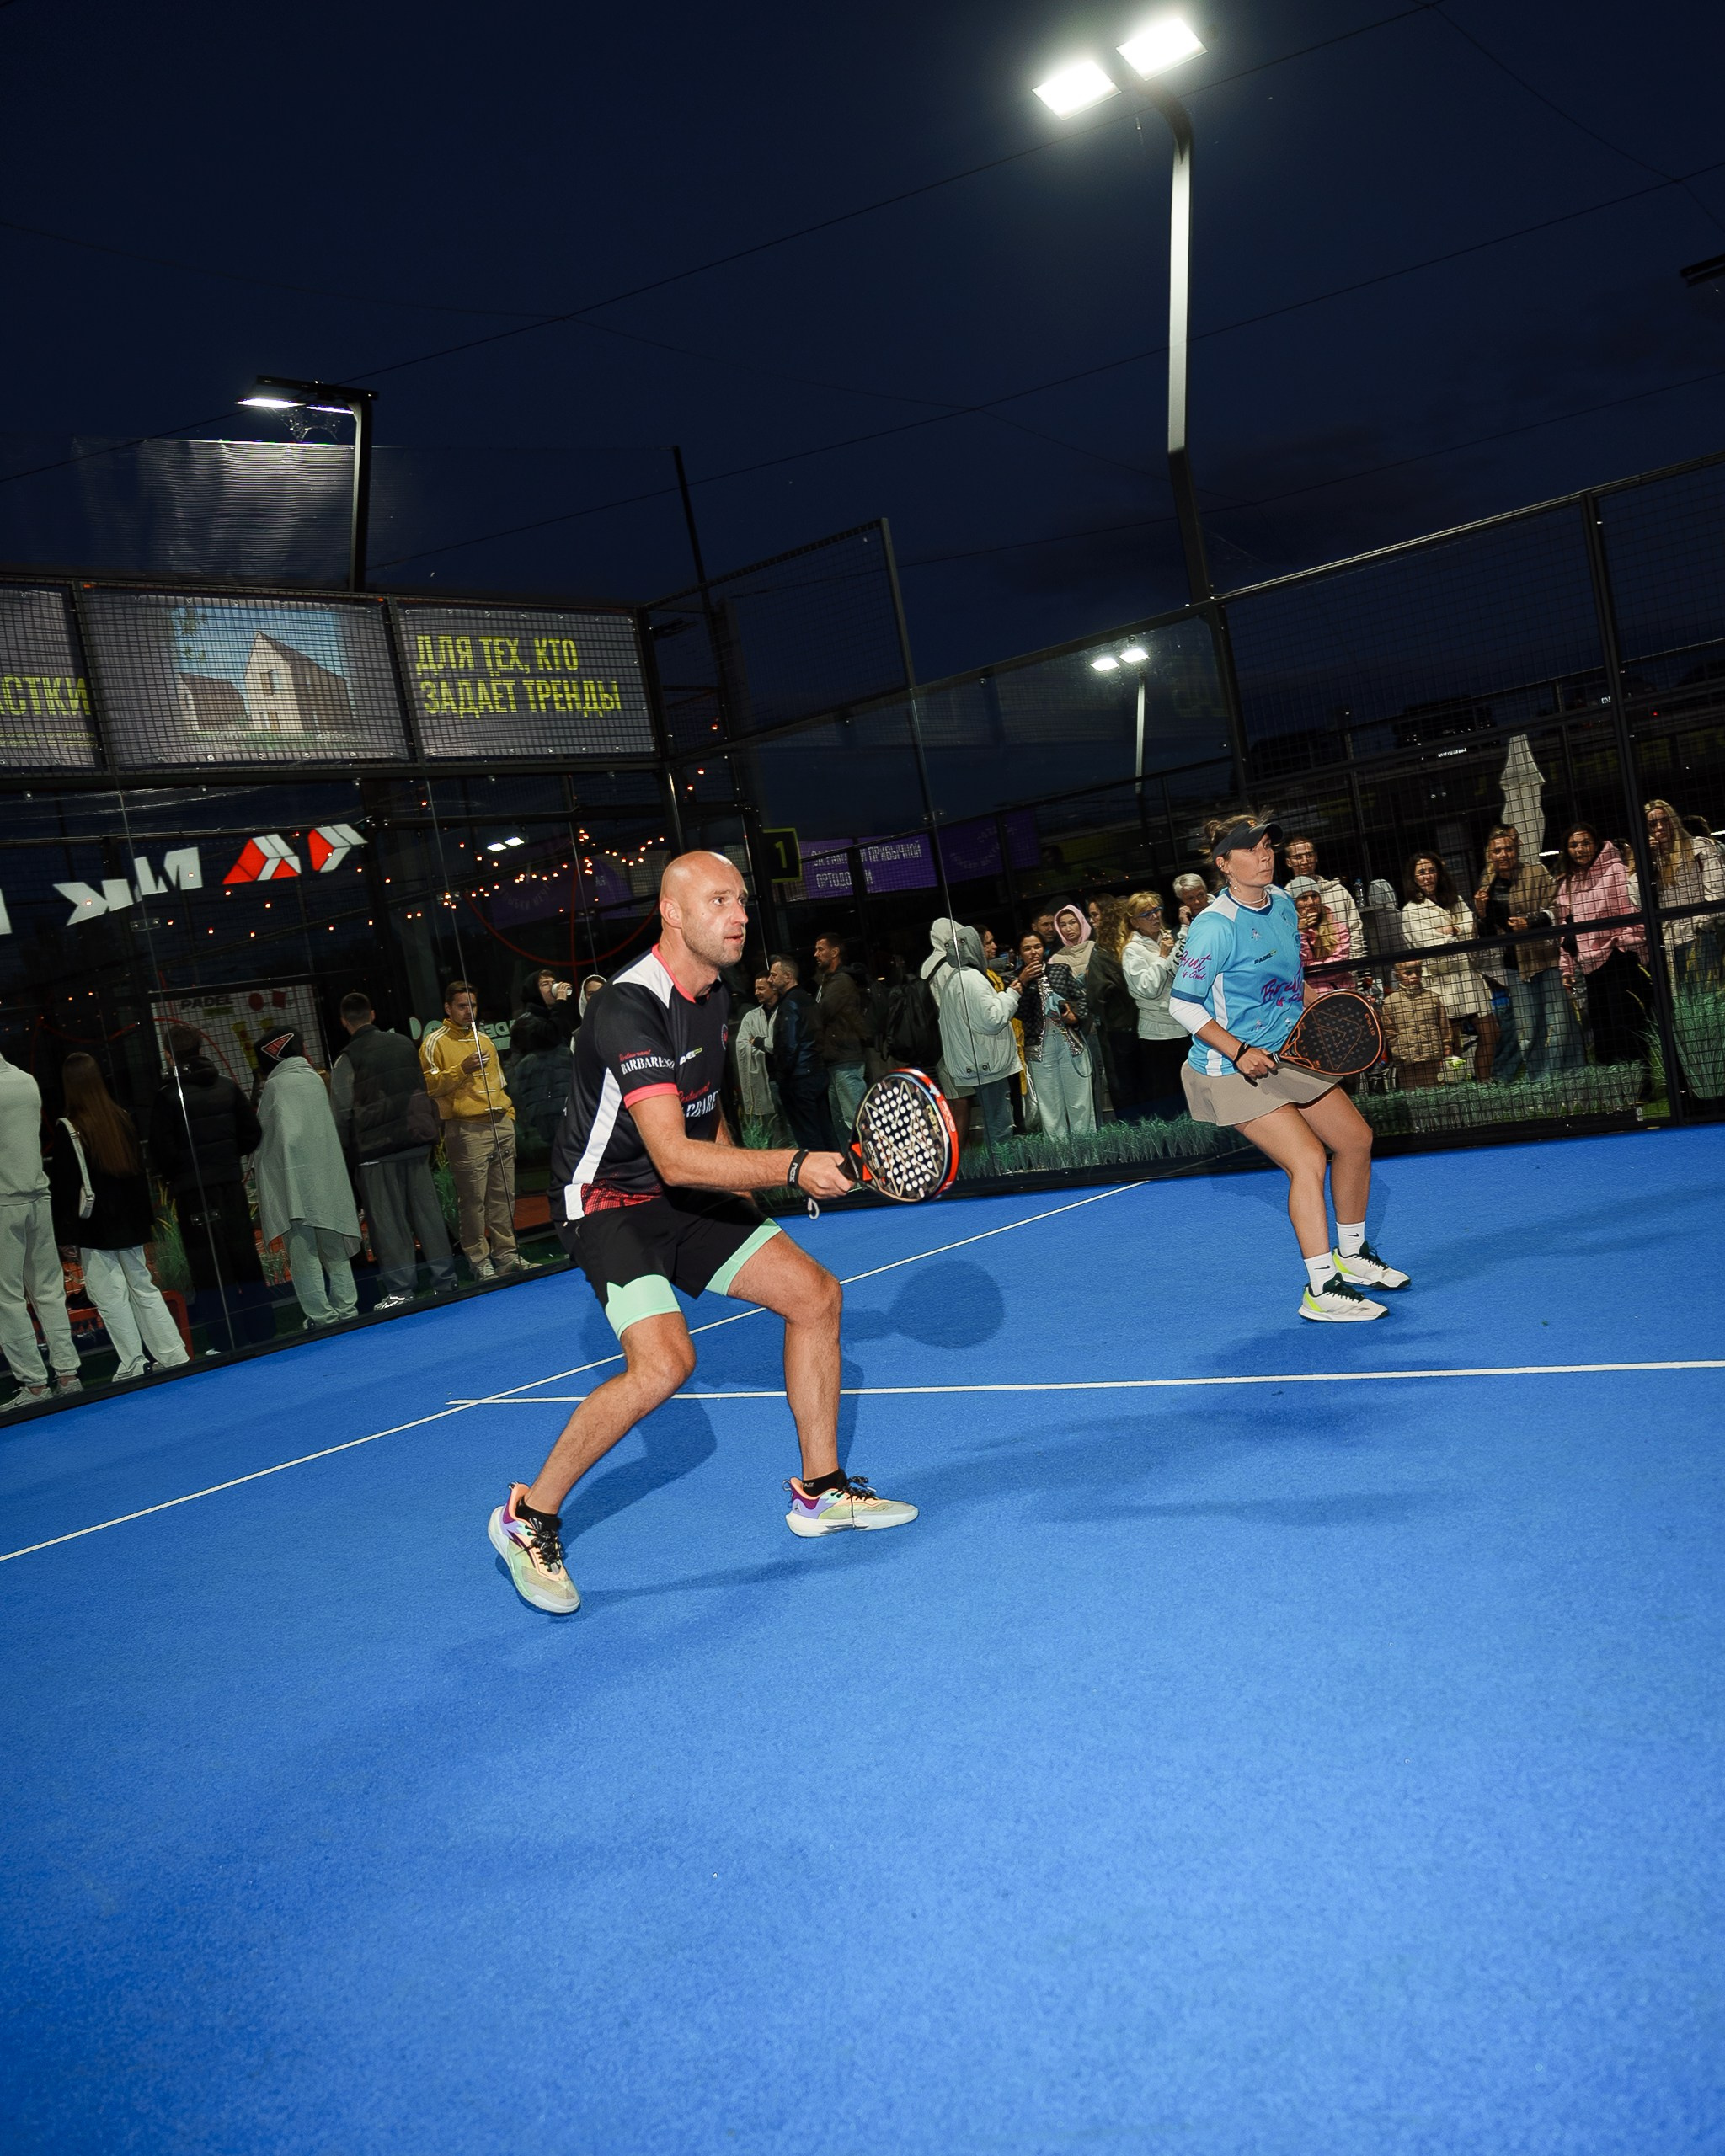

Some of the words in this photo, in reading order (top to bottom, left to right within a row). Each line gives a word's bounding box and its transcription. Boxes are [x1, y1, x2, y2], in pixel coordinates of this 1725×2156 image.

[416, 635, 475, 675] ДЛЯ
[478, 636, 531, 674] ТЕХ,
[534, 638, 579, 671] КТО
[0, 675, 91, 715] СТКИ
[420, 671, 517, 719] ЗАДАЁТ
[522, 680, 622, 718] ТРЕНДЫ
[774, 841, 788, 868] 1
[868, 840, 922, 862] ПРИВЫЧНОЙ
[180, 995, 233, 1010] PADEL
